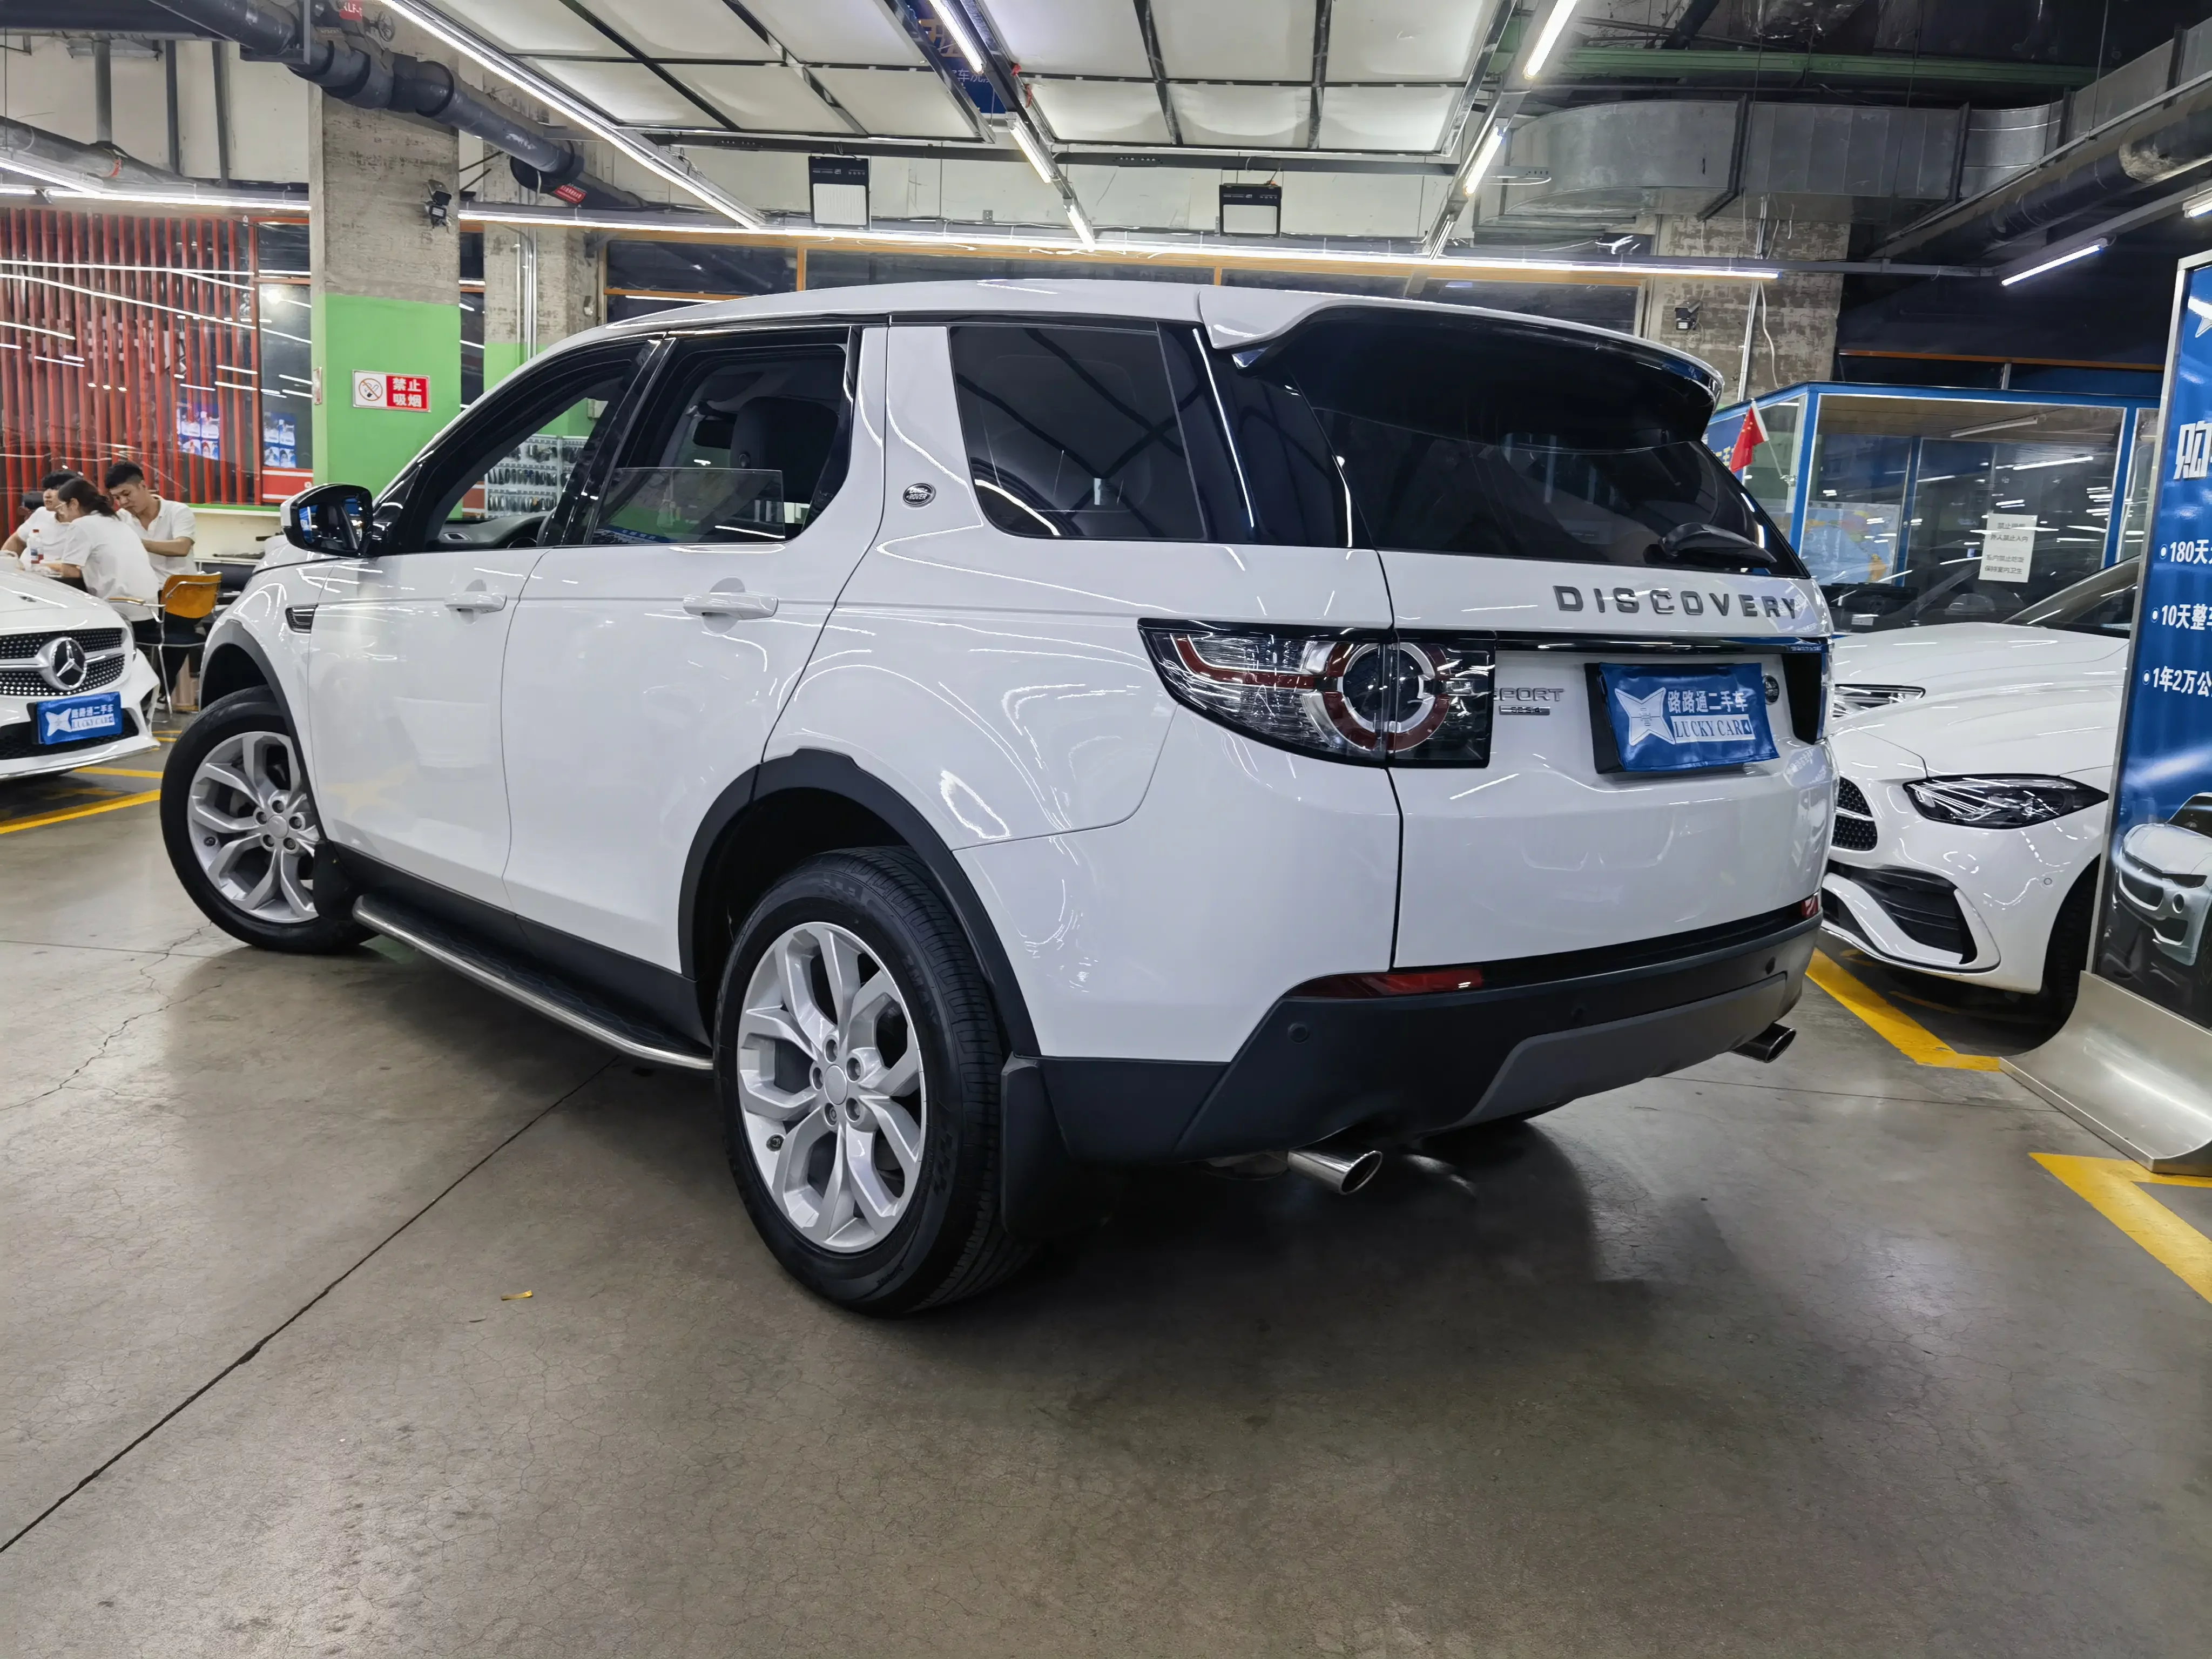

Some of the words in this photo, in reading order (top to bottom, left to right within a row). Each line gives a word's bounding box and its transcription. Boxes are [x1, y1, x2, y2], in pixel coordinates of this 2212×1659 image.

[393, 377, 422, 392] 禁止
[393, 393, 422, 408] 吸烟
[2173, 420, 2212, 480] 购
[2170, 539, 2212, 564] 180天
[1553, 585, 1796, 619] DISCOVERY
[2153, 666, 2212, 697] 1年2万公
[1668, 690, 1749, 713] 路路通二手车
[1673, 720, 1715, 738] LUCKY
[1717, 719, 1744, 736] CAR
